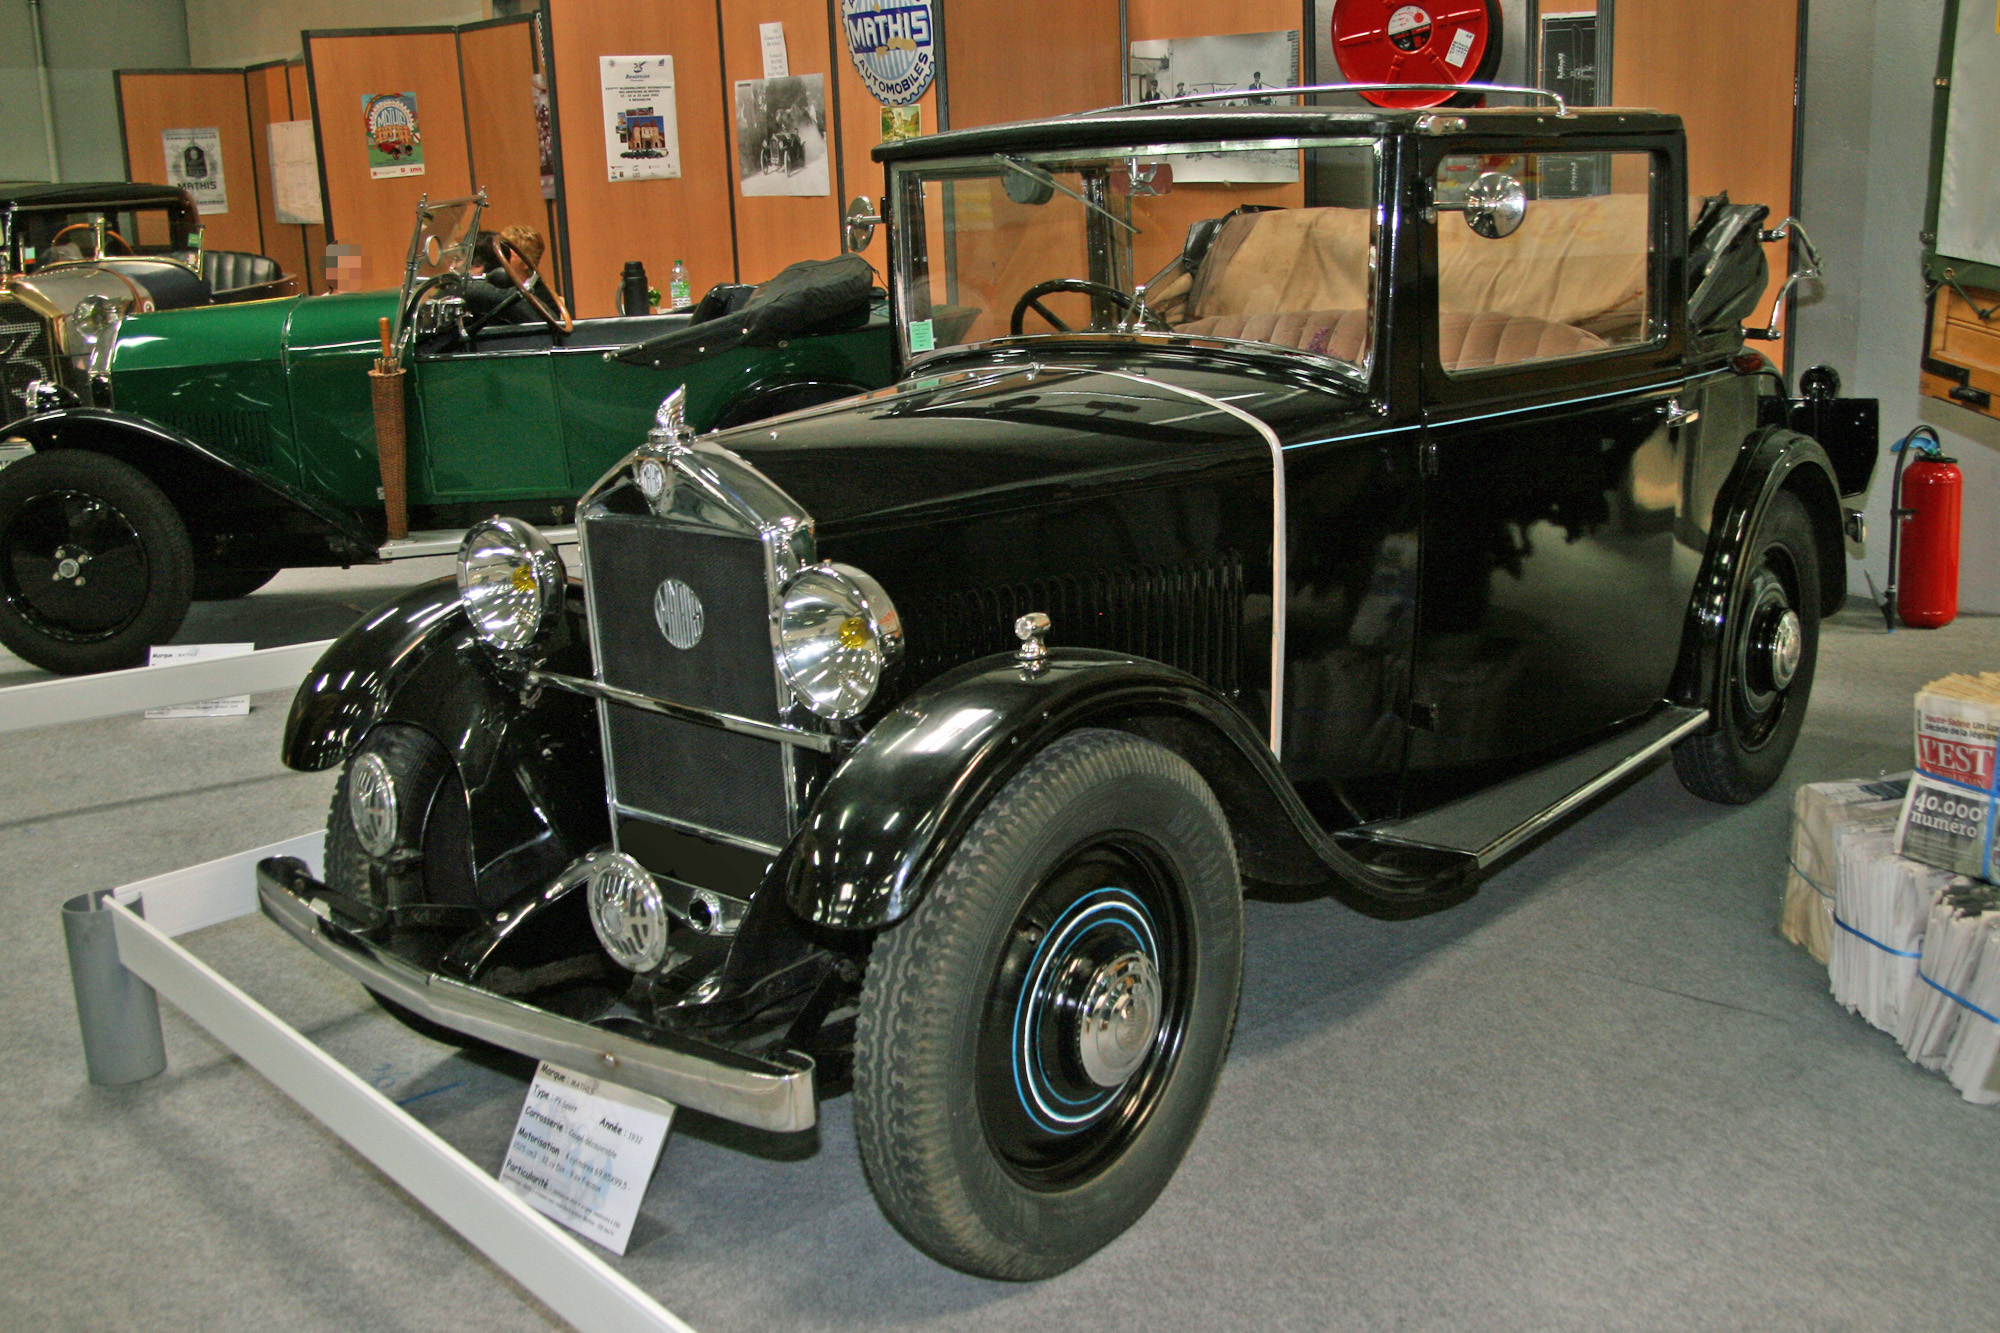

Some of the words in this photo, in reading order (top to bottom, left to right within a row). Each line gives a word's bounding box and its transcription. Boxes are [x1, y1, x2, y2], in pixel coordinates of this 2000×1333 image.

[848, 10, 930, 49] MATHIS
[858, 51, 929, 96] AUTOMOBILES
[177, 181, 217, 192] MATHIS
[1920, 738, 1994, 776] L'EST
[1911, 811, 1978, 838] numéro
[540, 1063, 566, 1083] Marque
[533, 1084, 549, 1100] Type
[524, 1106, 564, 1132] Carrosserie
[599, 1116, 623, 1136] Année
[517, 1127, 560, 1156] Motorisation
[506, 1158, 550, 1190] Particularité
